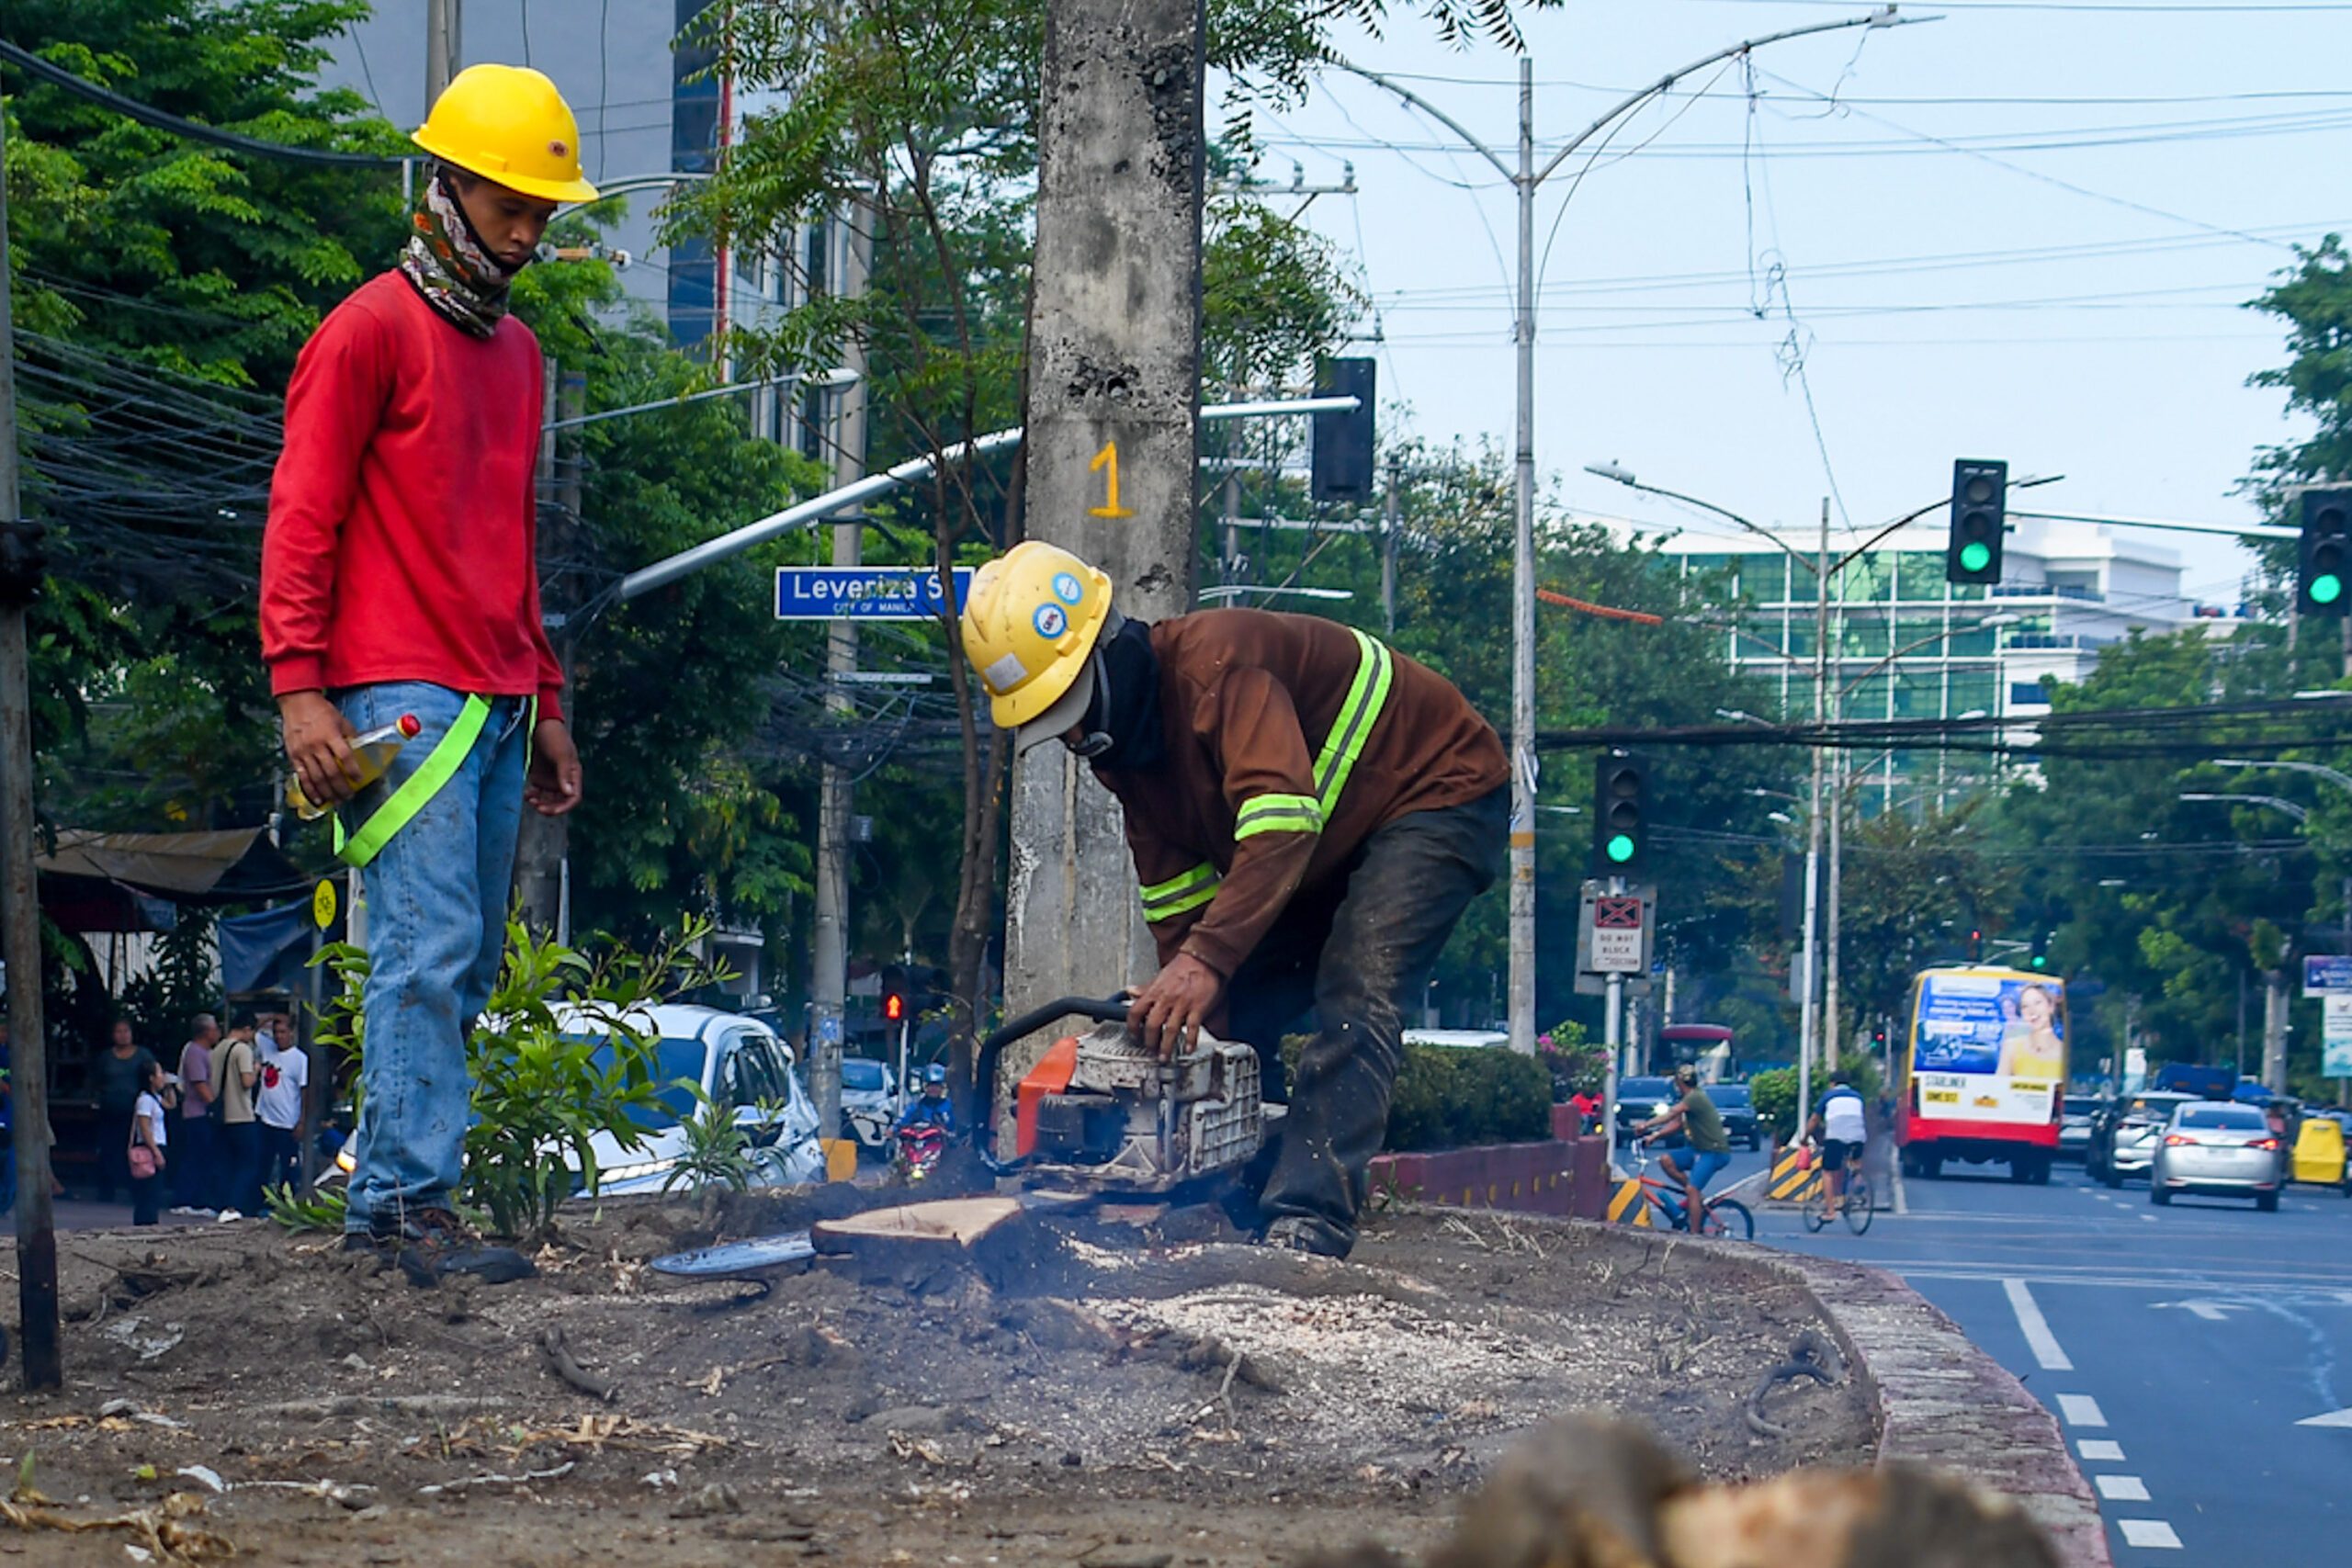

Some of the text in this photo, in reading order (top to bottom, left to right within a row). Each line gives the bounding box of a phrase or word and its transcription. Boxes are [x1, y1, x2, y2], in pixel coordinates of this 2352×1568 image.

[1087, 440, 1135, 519] 1
[794, 574, 945, 600] Leveriza S
[833, 603, 855, 613] CITY
[860, 604, 873, 613] OF
[1600, 934, 1634, 942] DO NOT
[1602, 946, 1631, 954] BLOCK
